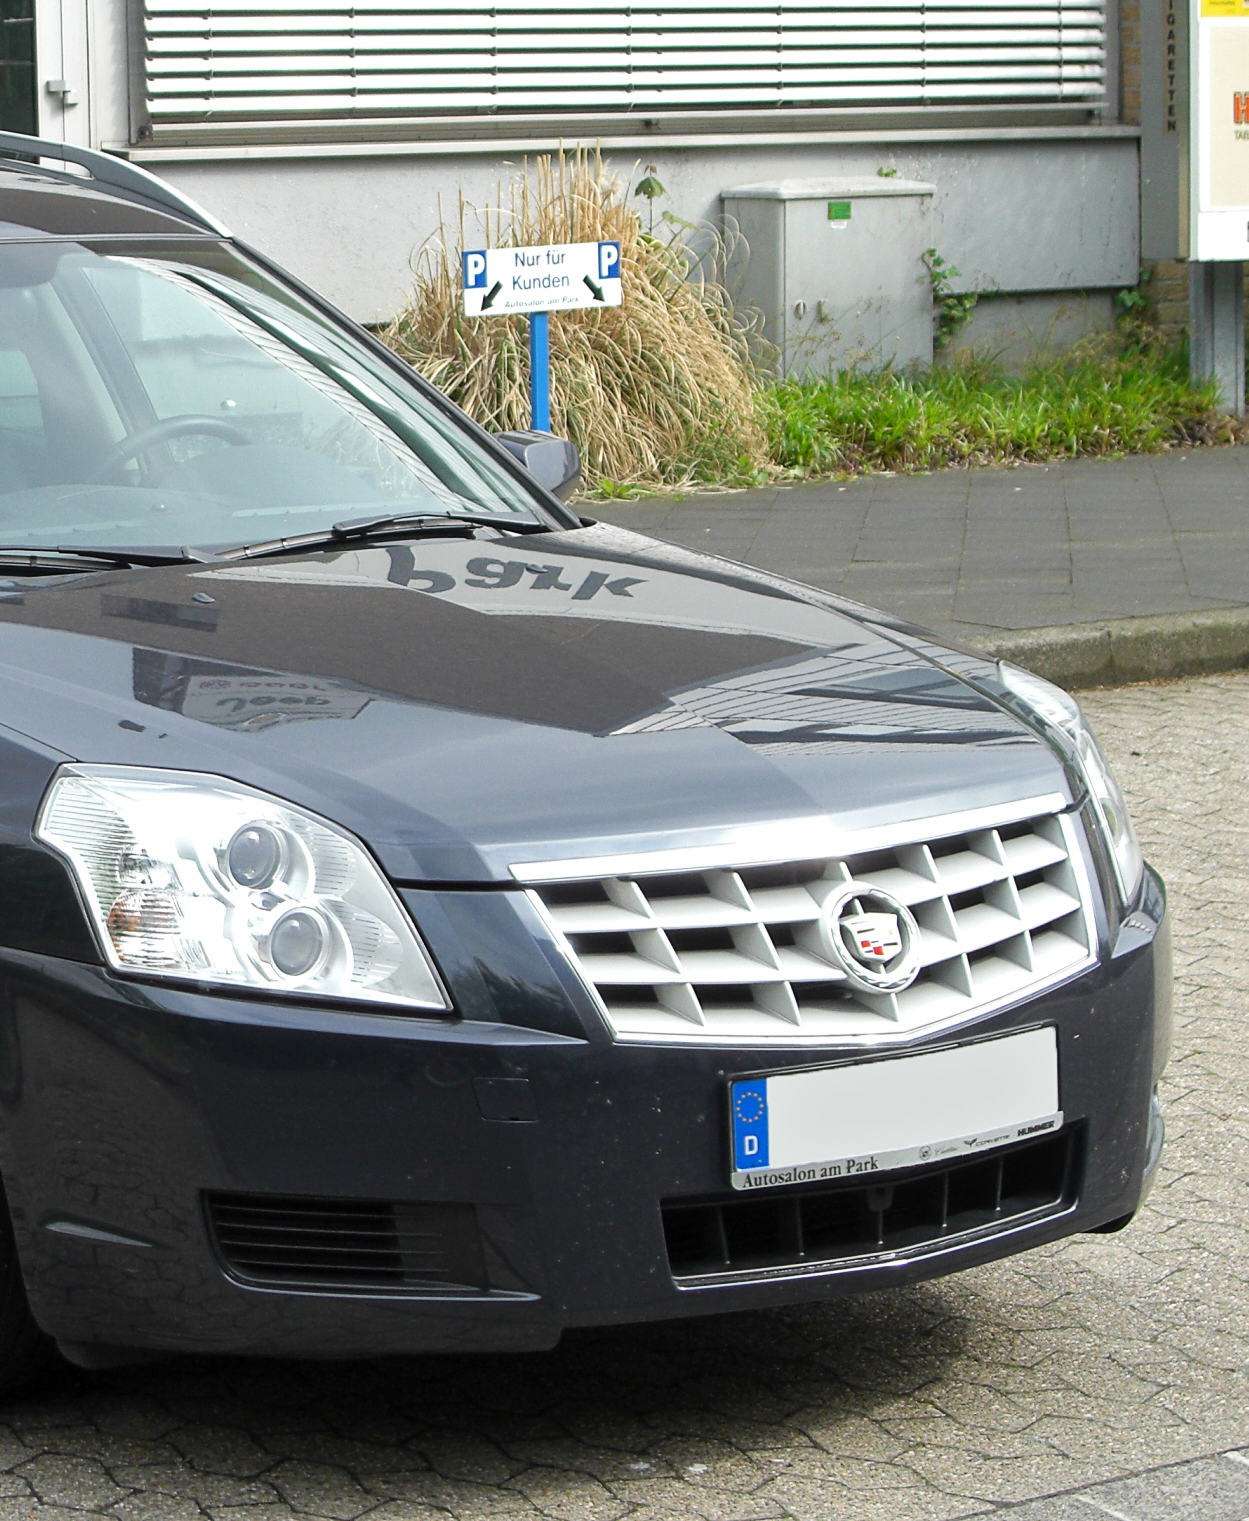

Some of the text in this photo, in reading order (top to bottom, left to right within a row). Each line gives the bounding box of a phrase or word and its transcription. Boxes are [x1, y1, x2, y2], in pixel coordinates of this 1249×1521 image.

[514, 249, 566, 267] Nur für
[601, 244, 619, 277] P
[467, 253, 485, 287] P
[512, 273, 570, 291] Kunden
[1017, 1120, 1055, 1137] HUMMER
[744, 1135, 758, 1156] D
[742, 1156, 879, 1189] Autosalon am Park
